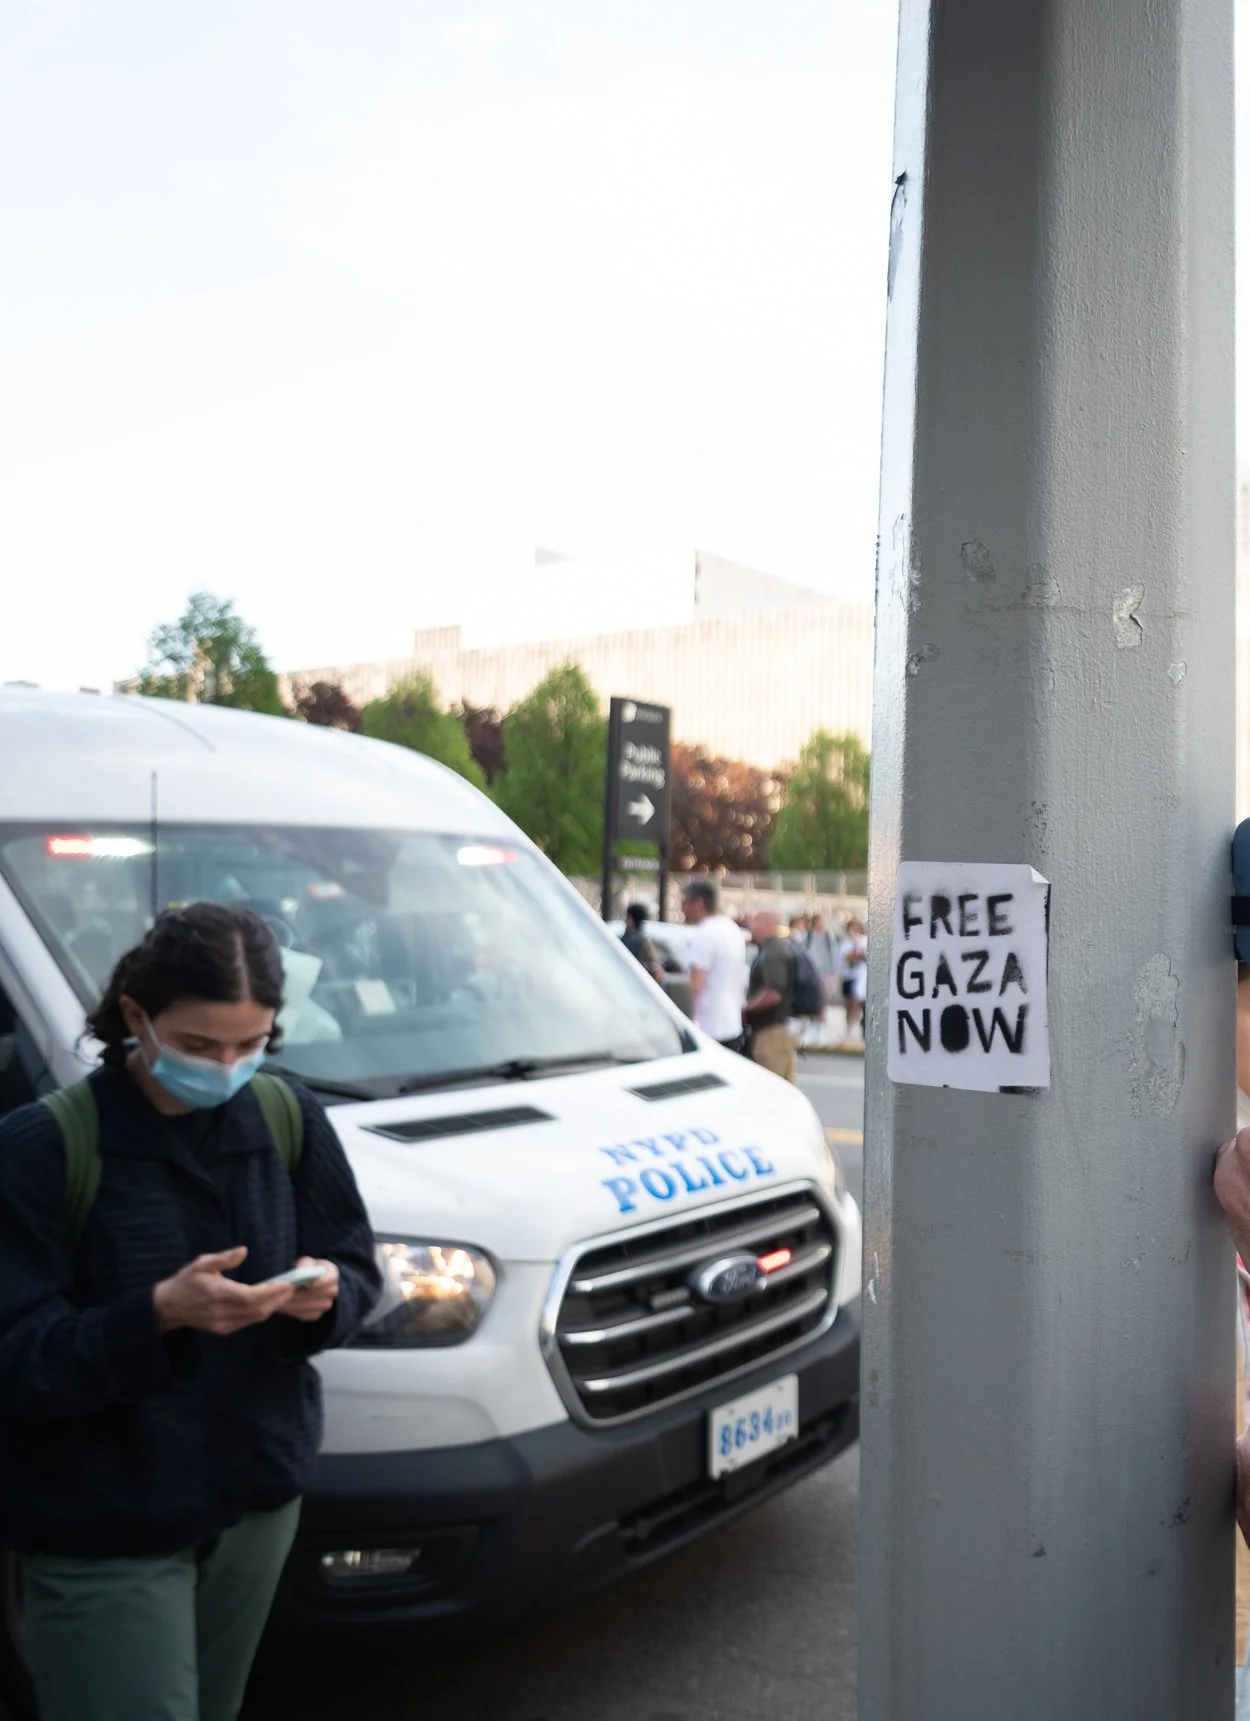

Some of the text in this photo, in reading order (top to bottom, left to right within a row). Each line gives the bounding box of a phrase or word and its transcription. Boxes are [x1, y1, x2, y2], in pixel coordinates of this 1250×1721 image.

[619, 760, 665, 790] Parking
[622, 741, 662, 765] Public
[902, 893, 1014, 940] FREE
[897, 950, 1028, 999] GAZA
[897, 1004, 1028, 1054] NOW
[600, 1127, 719, 1166] NYPD
[602, 1146, 774, 1213] POLICE
[720, 1405, 773, 1456] 8634
